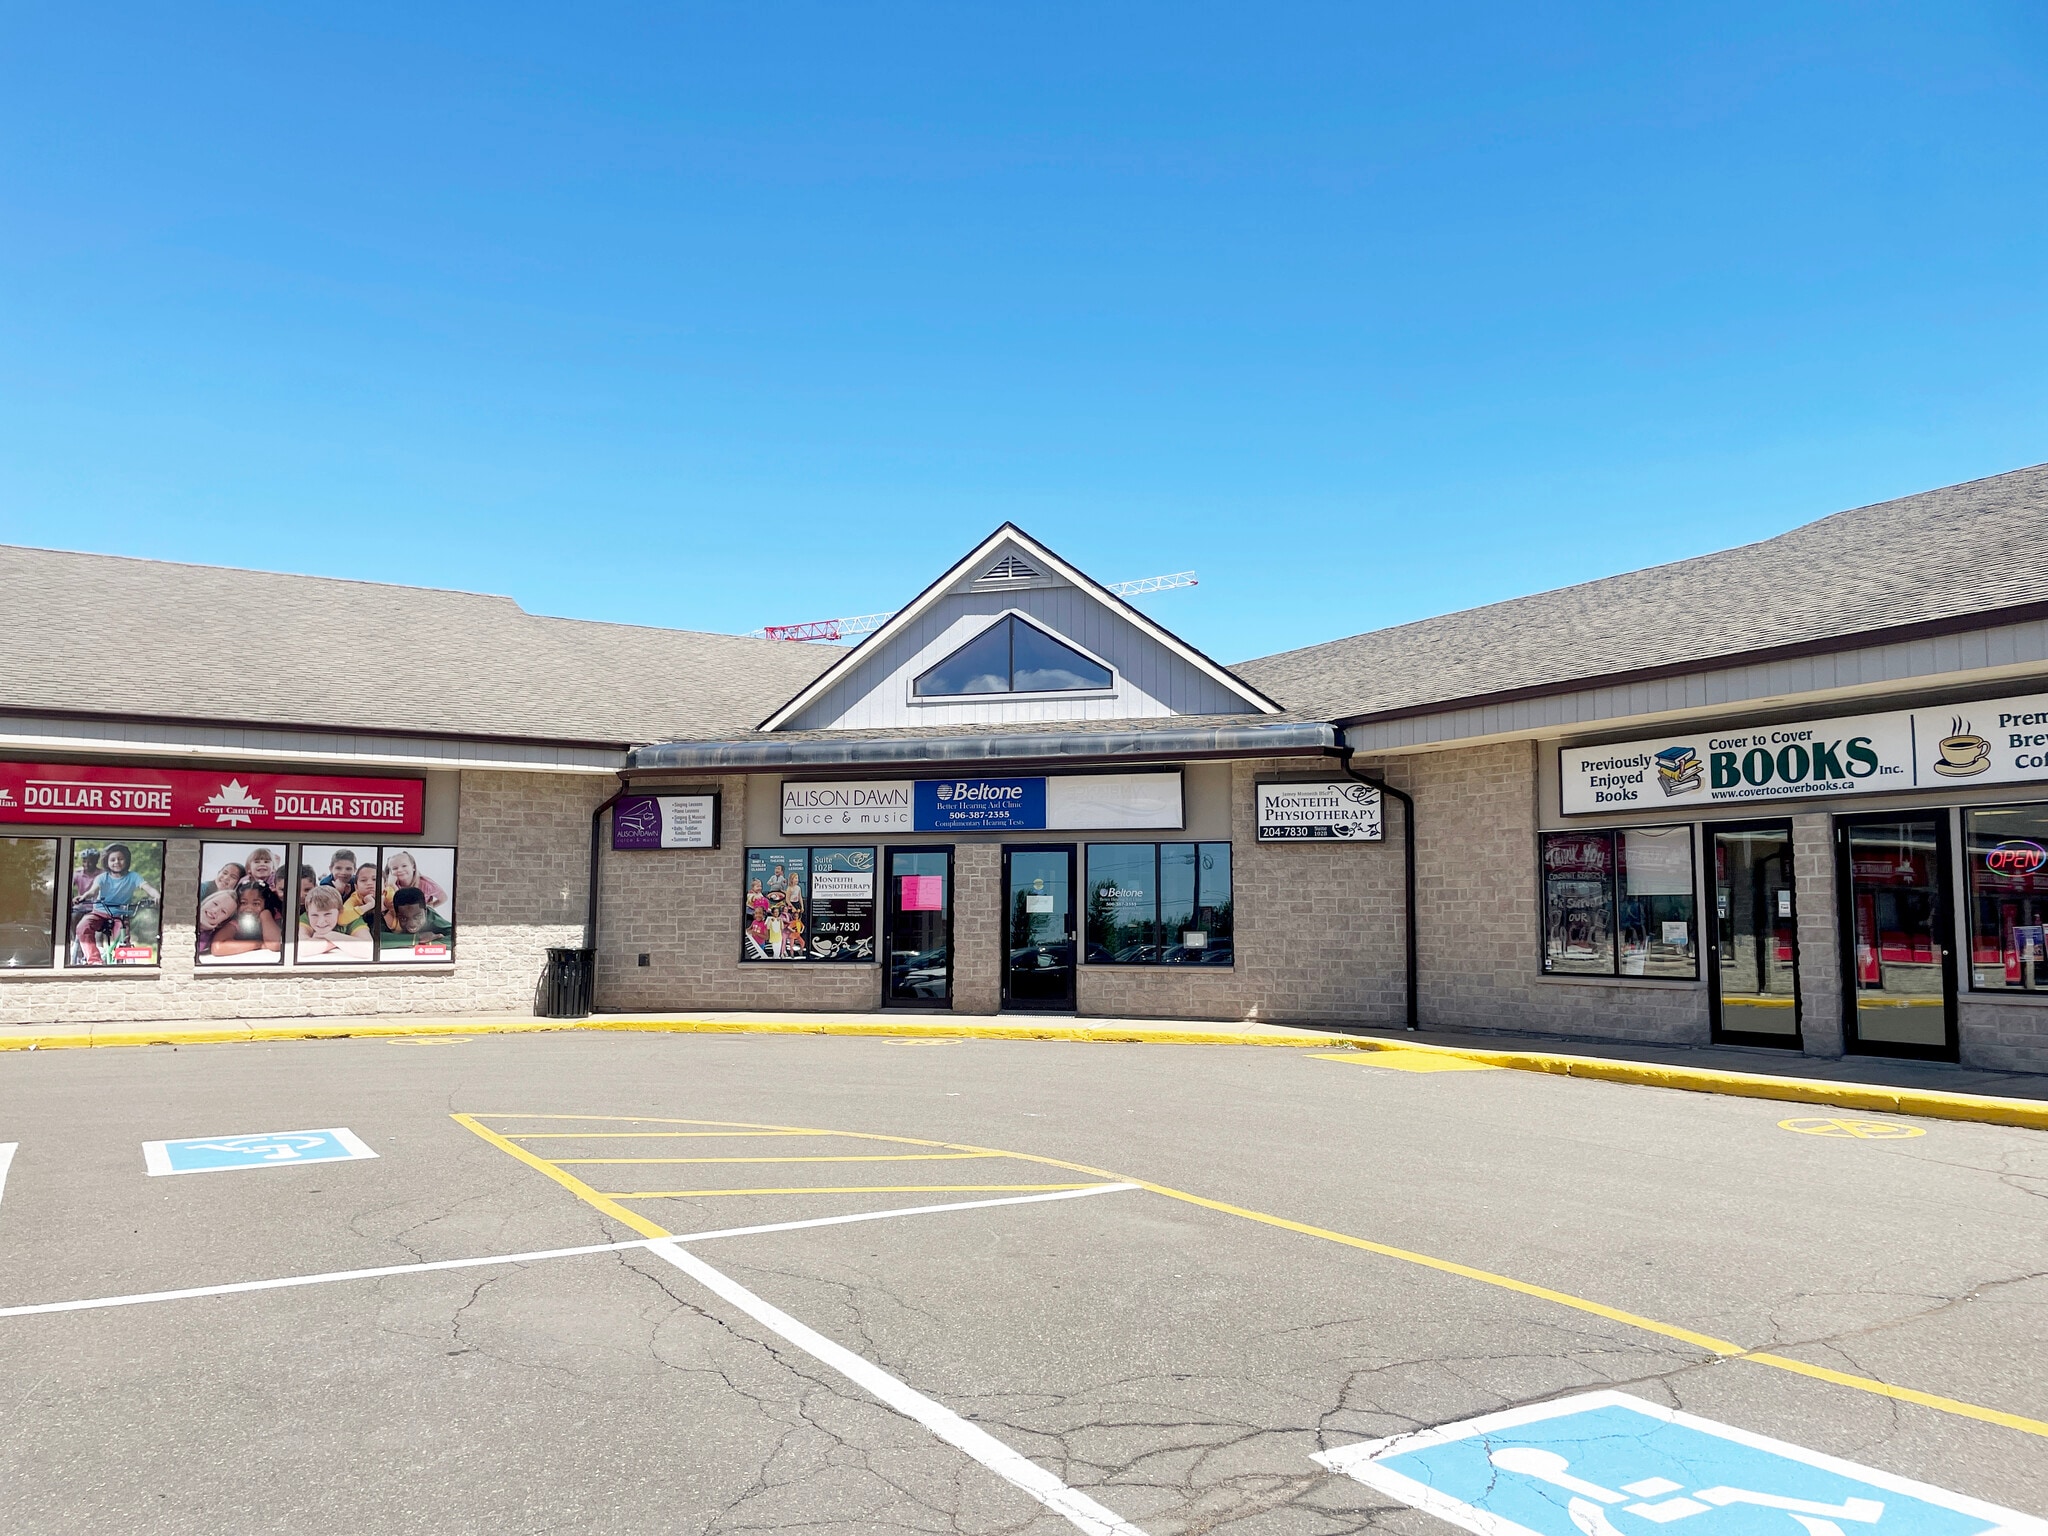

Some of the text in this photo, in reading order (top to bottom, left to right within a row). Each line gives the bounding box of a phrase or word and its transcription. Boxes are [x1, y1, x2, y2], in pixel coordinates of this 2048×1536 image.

[1709, 730, 1813, 750] Cover to Cover
[2008, 734, 2048, 748] Bre
[1581, 754, 1652, 772] Previously
[1710, 737, 1904, 789] BOOKS Inc.
[1590, 771, 1643, 789] Enjoyed
[953, 783, 1022, 800] Beltone
[1595, 788, 1638, 803] Books
[1711, 781, 1854, 799] www.covertocoverbooks.ca
[0, 799, 18, 807] ian
[24, 787, 172, 809] DOLLAR STORE
[785, 789, 908, 807] ALISON DAWN
[1265, 796, 1339, 808] MONTEITH
[198, 806, 269, 815] Great Canadian
[275, 796, 404, 817] DOLLAR STORE
[937, 802, 957, 810] Better
[960, 801, 986, 809] Hearing
[1002, 800, 1022, 808] Clinic
[784, 811, 908, 824] voice & music
[949, 811, 1010, 819] 506-387-2355
[1265, 809, 1375, 821] PHYSIOTHERAPY
[982, 819, 1006, 827] Hearing
[617, 830, 638, 838] ALISON
[1263, 827, 1308, 837] 204-7830
[1989, 850, 2041, 868] OPEN
[1108, 888, 1143, 897] Beltone
[1569, 912, 1588, 922] OUR
[821, 923, 860, 931] 204-7830
